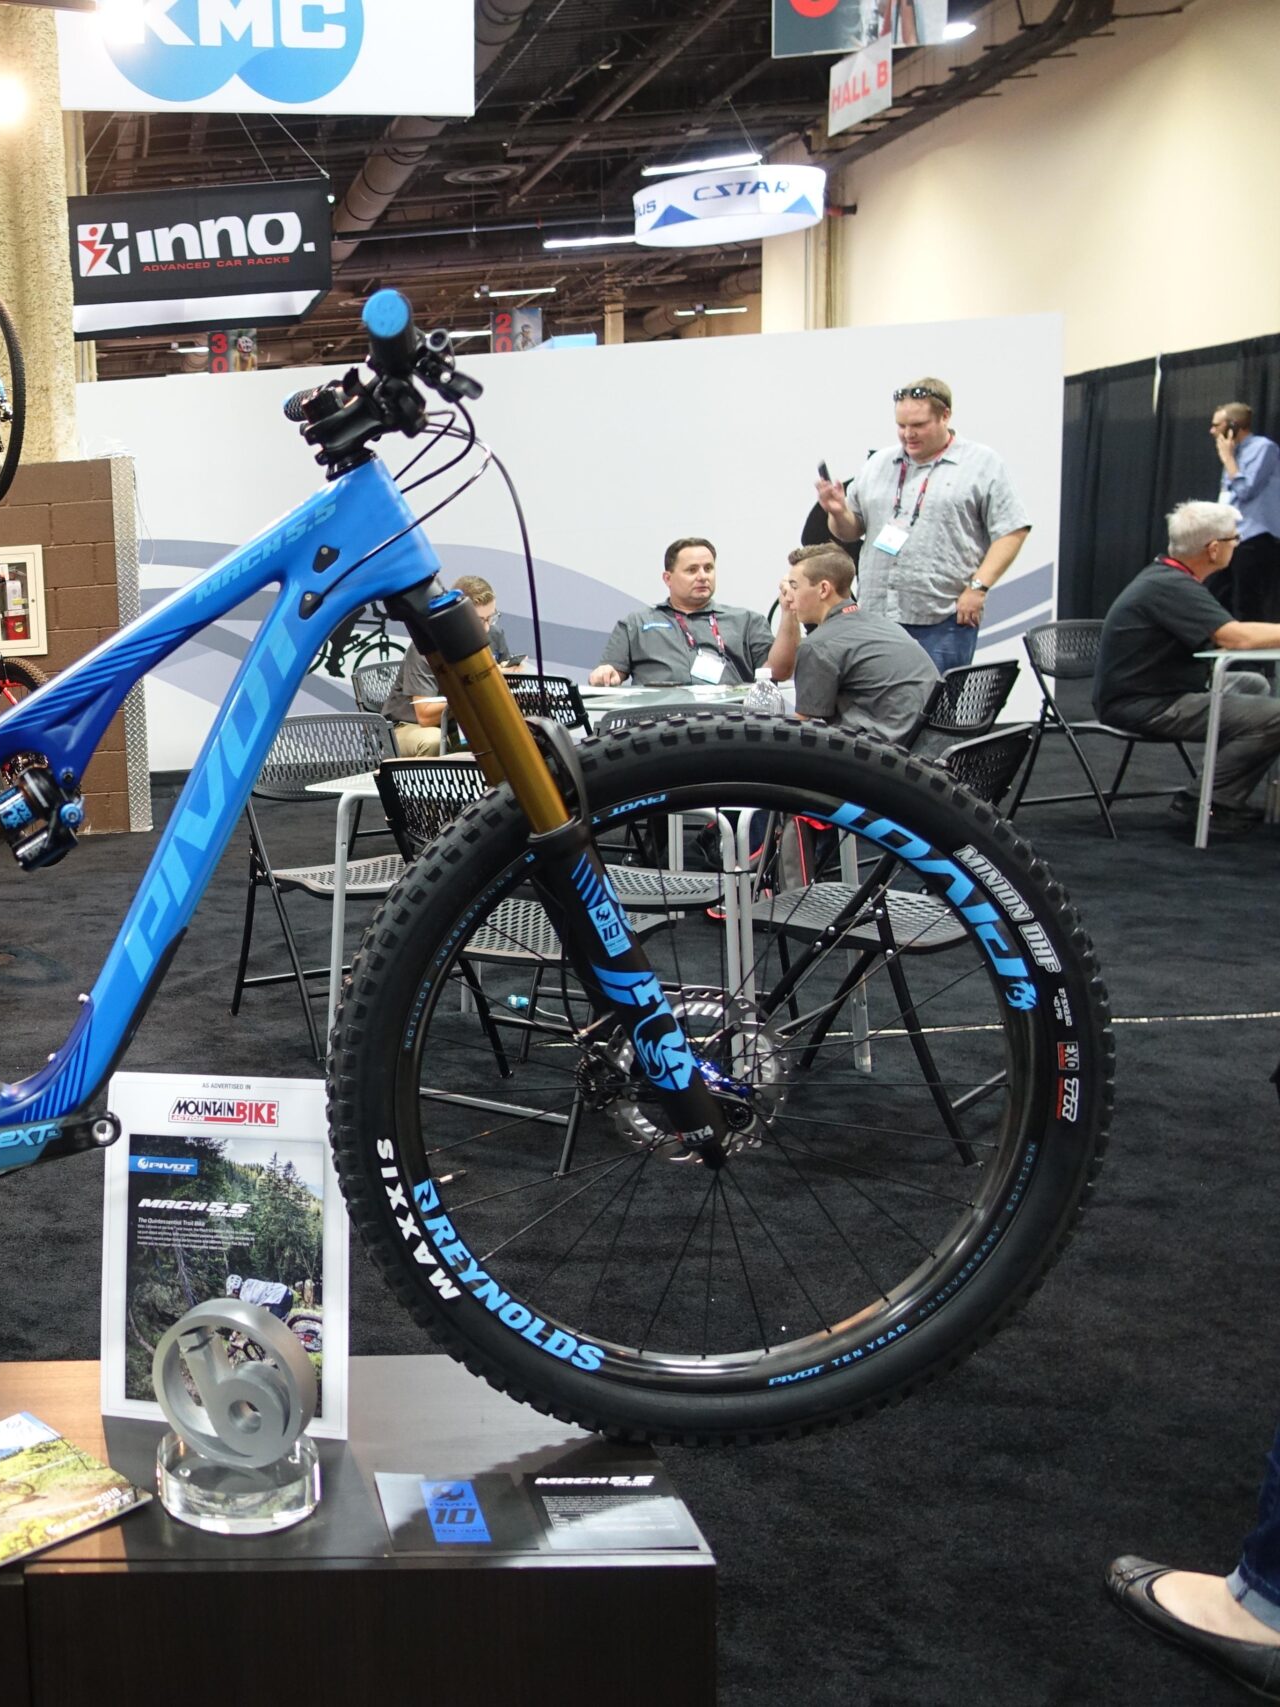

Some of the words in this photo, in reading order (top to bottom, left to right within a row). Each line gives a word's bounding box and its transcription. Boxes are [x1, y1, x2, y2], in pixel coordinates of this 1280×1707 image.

[831, 70, 871, 113] HALL
[876, 60, 889, 89] B
[142, 261, 211, 273] ADVANCED
[216, 258, 242, 268] CAR
[247, 255, 290, 267] RACKS
[194, 538, 284, 604] MACH
[286, 500, 337, 546] 5.5
[124, 612, 297, 983] PIVOT
[608, 794, 667, 817] PIVOT
[801, 801, 1028, 978] PIVOT
[953, 845, 1035, 922] MINION
[1019, 921, 1061, 974] DHF
[602, 922, 621, 941] 10
[1065, 1042, 1080, 1071] EXO
[173, 1099, 235, 1118] MOUNTAIN
[235, 1101, 277, 1125] BIKE
[148, 1161, 195, 1172] PIVOT
[138, 1197, 208, 1211] MACH
[206, 1201, 252, 1214] 5.5
[376, 1138, 462, 1301] MAXXIS
[423, 1214, 605, 1372] REYNOLDS
[768, 1364, 825, 1386] PIVOT
[831, 1348, 864, 1367] TEN
[866, 1322, 908, 1350] YEAR
[919, 1223, 1002, 1316] ANNIVERSARY
[534, 1476, 609, 1486] MACH
[435, 1508, 477, 1525] 10
